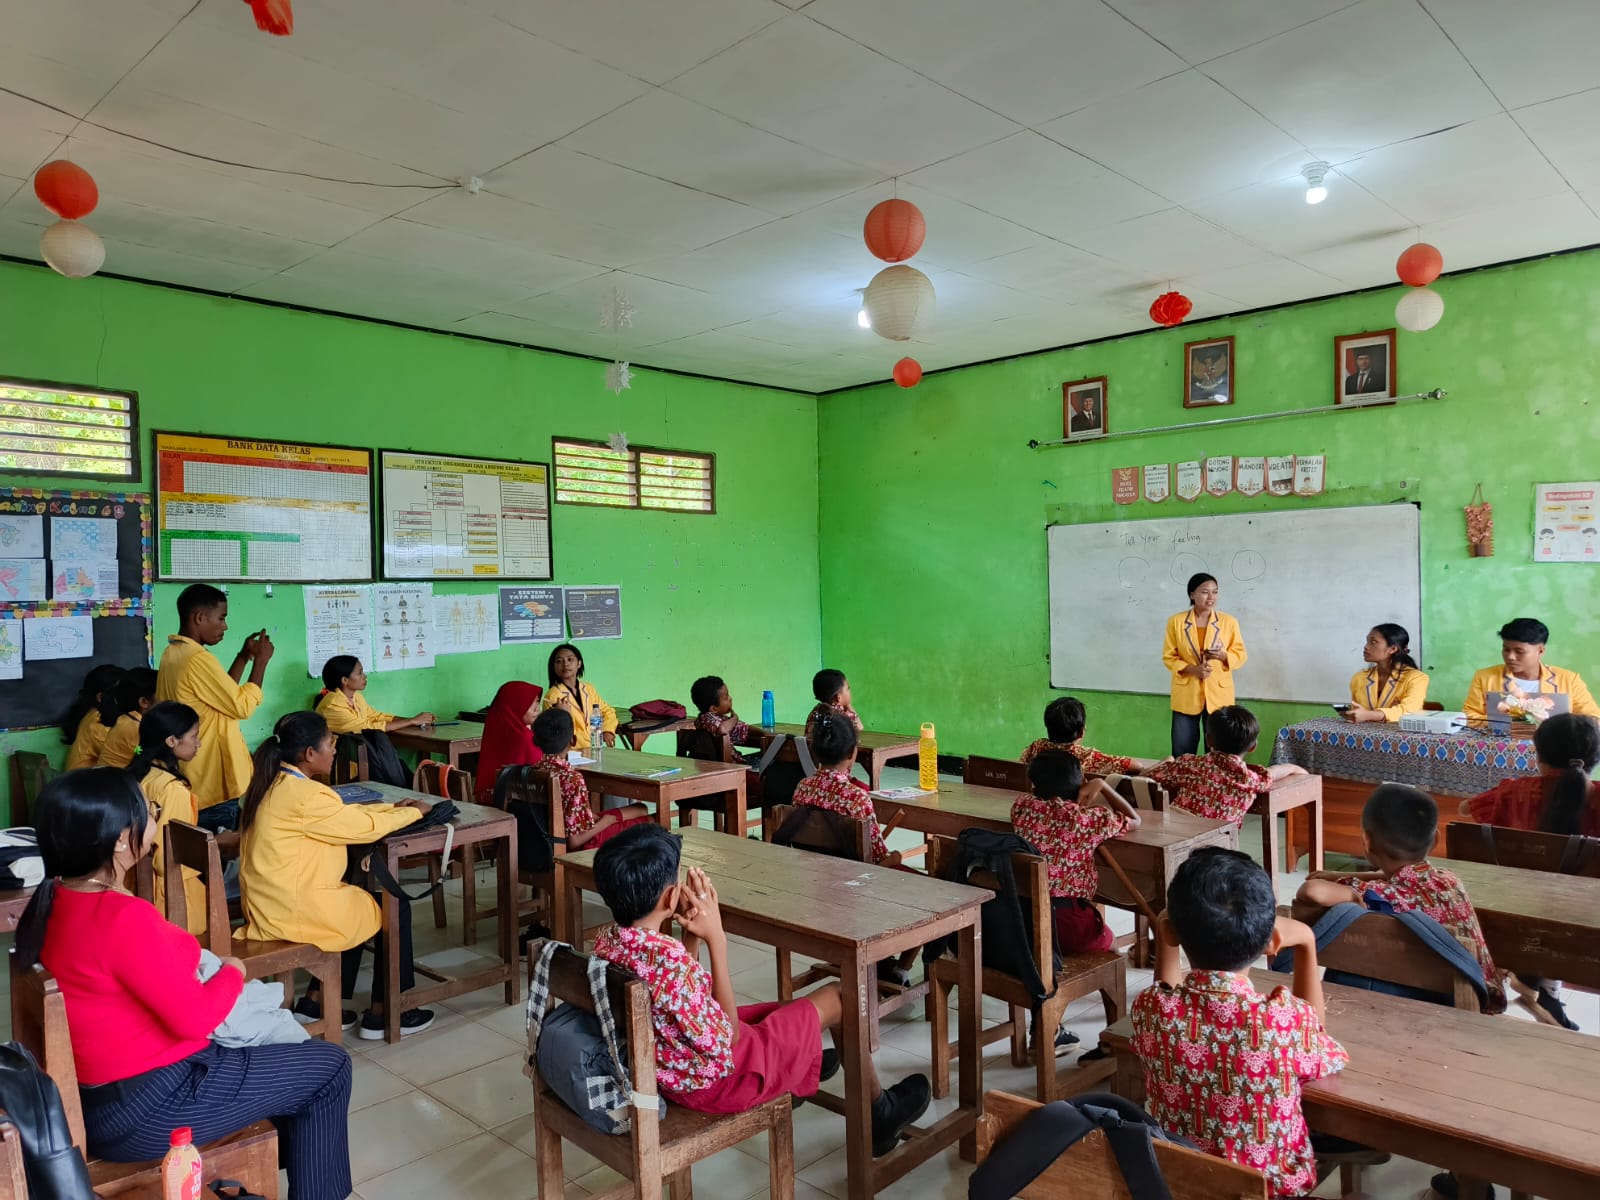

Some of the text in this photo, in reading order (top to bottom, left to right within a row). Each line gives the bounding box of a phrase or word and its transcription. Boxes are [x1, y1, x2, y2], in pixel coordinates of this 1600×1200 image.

[227, 440, 311, 455] BANK DATA KELAS
[1269, 461, 1294, 471] KREATI
